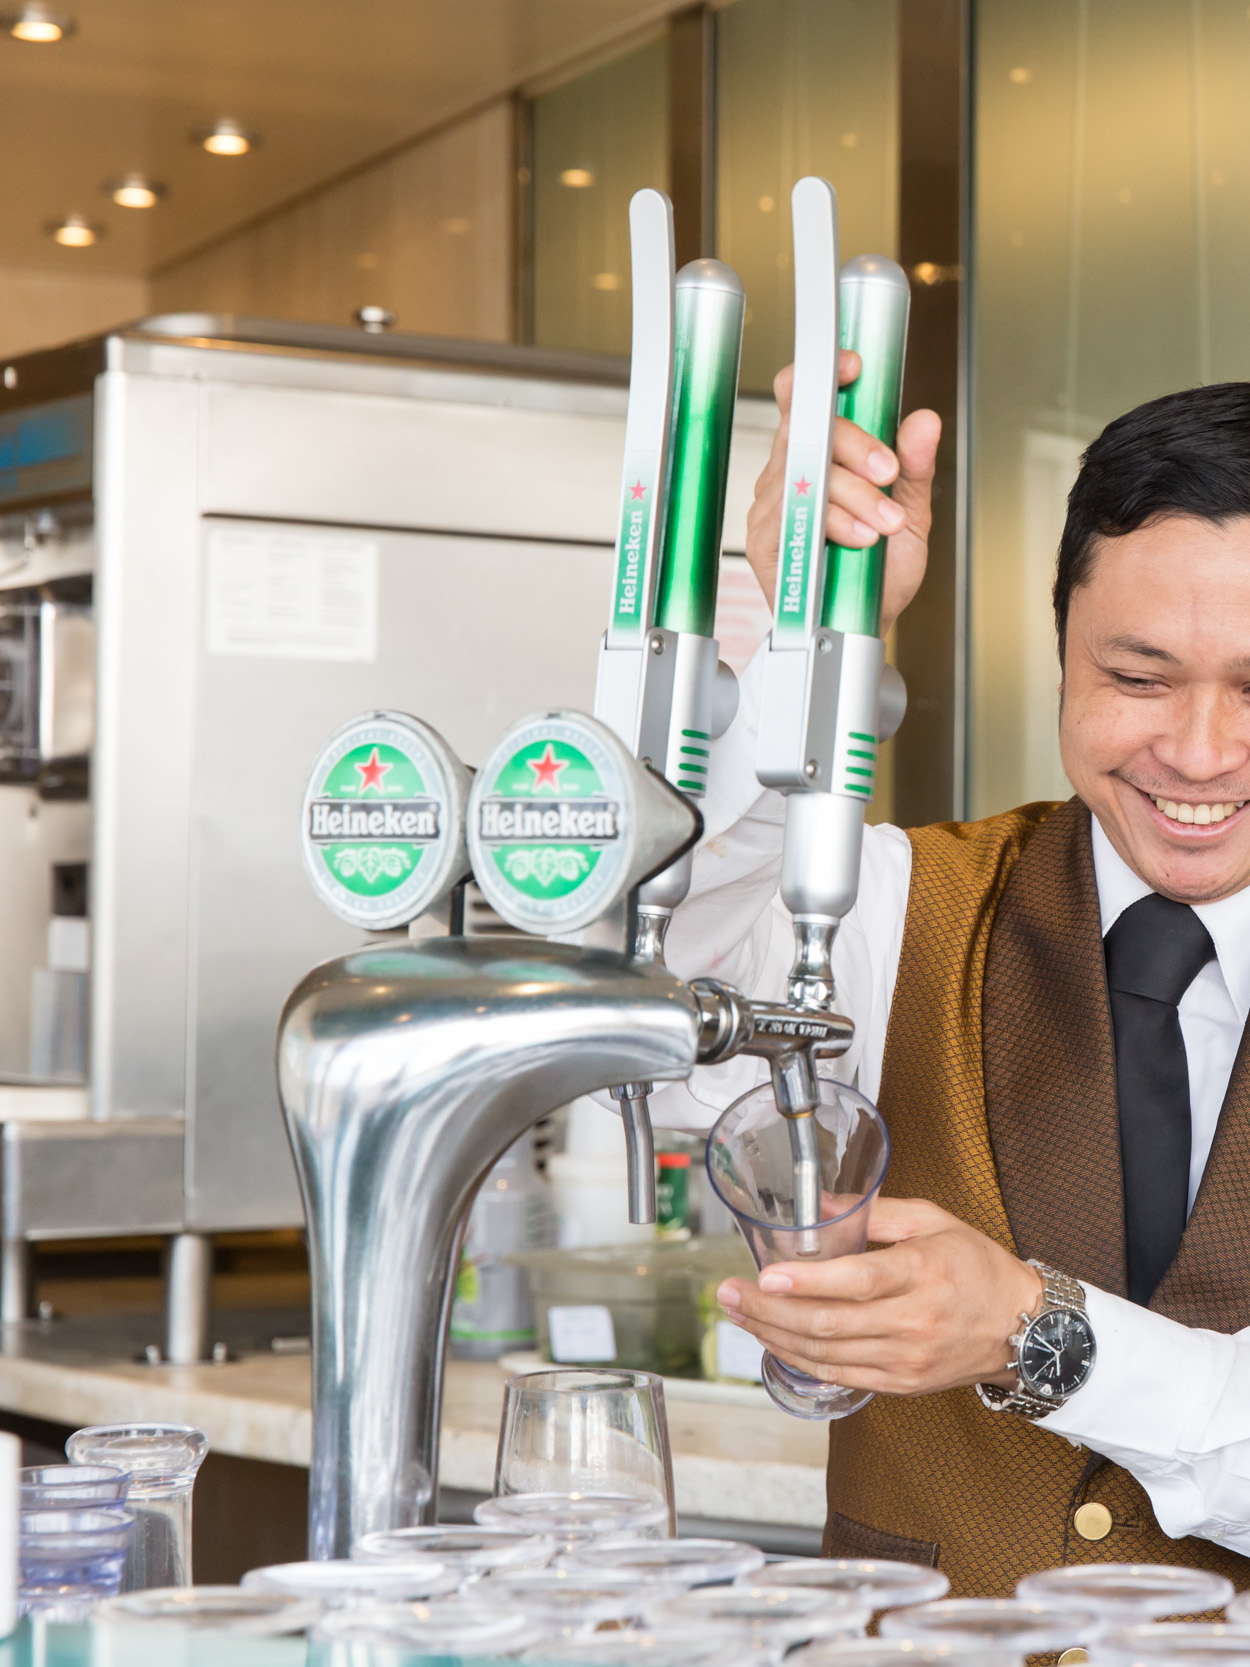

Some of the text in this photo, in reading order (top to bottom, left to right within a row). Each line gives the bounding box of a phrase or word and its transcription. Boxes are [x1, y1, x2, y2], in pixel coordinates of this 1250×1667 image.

[619, 511, 643, 614] Heineken
[783, 506, 808, 613] Heineken
[312, 804, 437, 836] Heineken
[481, 803, 615, 837] Heineken
